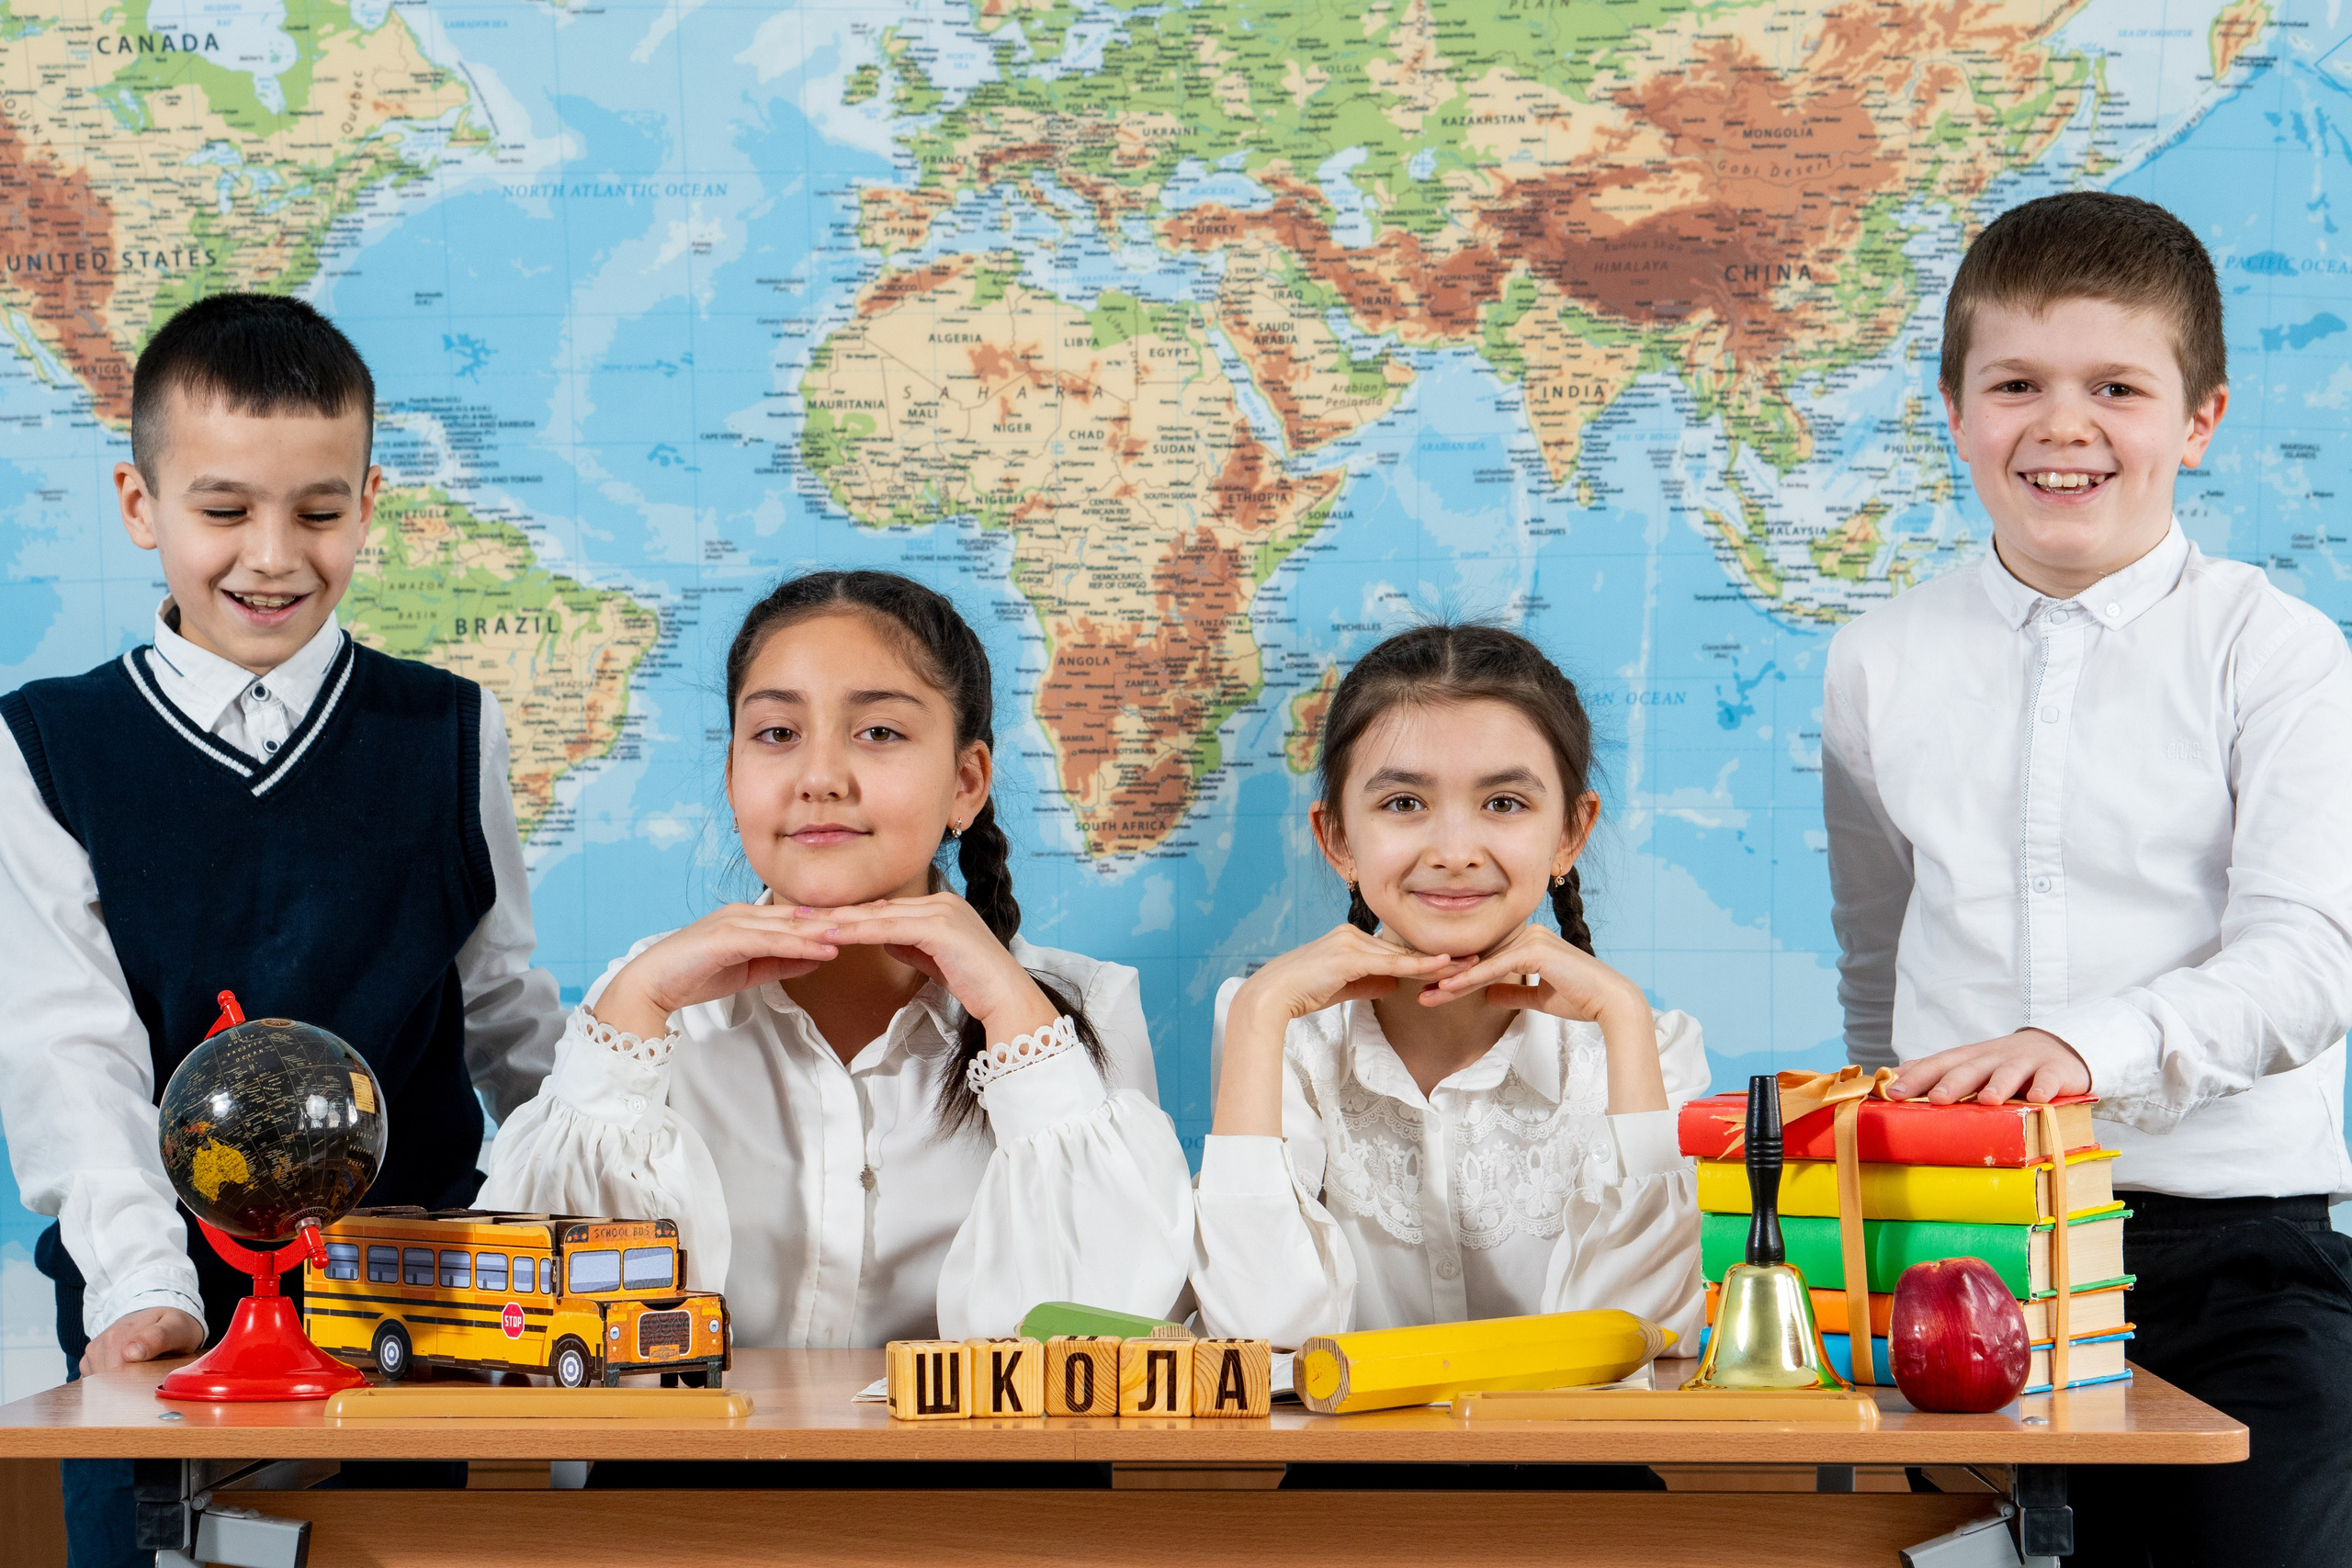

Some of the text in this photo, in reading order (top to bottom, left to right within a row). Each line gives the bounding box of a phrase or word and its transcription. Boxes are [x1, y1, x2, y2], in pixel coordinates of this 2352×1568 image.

[96, 33, 220, 55] CANADA
[1442, 115, 1526, 127] KAZAKHSTAN
[1142, 127, 1198, 137] UKRAINE
[1743, 129, 1814, 139] MONGOLIA
[922, 155, 968, 165] FRANCE
[503, 183, 728, 198] NORTH ATLANTIC OCEAN
[1012, 190, 1046, 199] ITALY
[884, 228, 920, 237] SPAIN
[1190, 226, 1237, 235] TURKEY
[6, 249, 217, 273] UNITED STATES
[2224, 254, 2295, 270] PACIFIC
[1594, 261, 1668, 273] HIMALAYA
[1724, 264, 1812, 283] CHINA
[1273, 290, 1304, 300] IRAQ
[1362, 296, 1391, 306] IRAN
[1257, 322, 1295, 333] SAUDI
[928, 333, 982, 344] ALGERIA
[1064, 338, 1100, 347] LIBYA
[1253, 335, 1298, 345] ARABIA
[1149, 348, 1190, 357] EGYPT
[1543, 385, 1604, 398] INDIA
[808, 400, 886, 410] MAURITANIA
[908, 409, 938, 419] MALI
[993, 423, 1032, 433] NIGER
[1069, 430, 1104, 439] CHAD
[1153, 445, 1195, 454] SUDAN
[975, 495, 1025, 504] NIGERIA
[1227, 493, 1286, 503] ETHIOPIA
[379, 509, 450, 519] VENEZUELA
[1307, 511, 1354, 520] SOMALIA
[1765, 526, 1827, 536] MALAYSIA
[389, 581, 445, 592] AMAZON
[398, 611, 437, 621] BASIN
[455, 616, 558, 637] BRAZIL
[1057, 657, 1111, 666] ANGOLA
[1625, 691, 1687, 705] OCEAN
[1075, 821, 1166, 832] SOUTH AFRICA
[594, 1224, 650, 1239] SCHOOL BUS
[504, 1314, 522, 1328] STOP
[916, 1348, 1248, 1416] ШКОЛА
